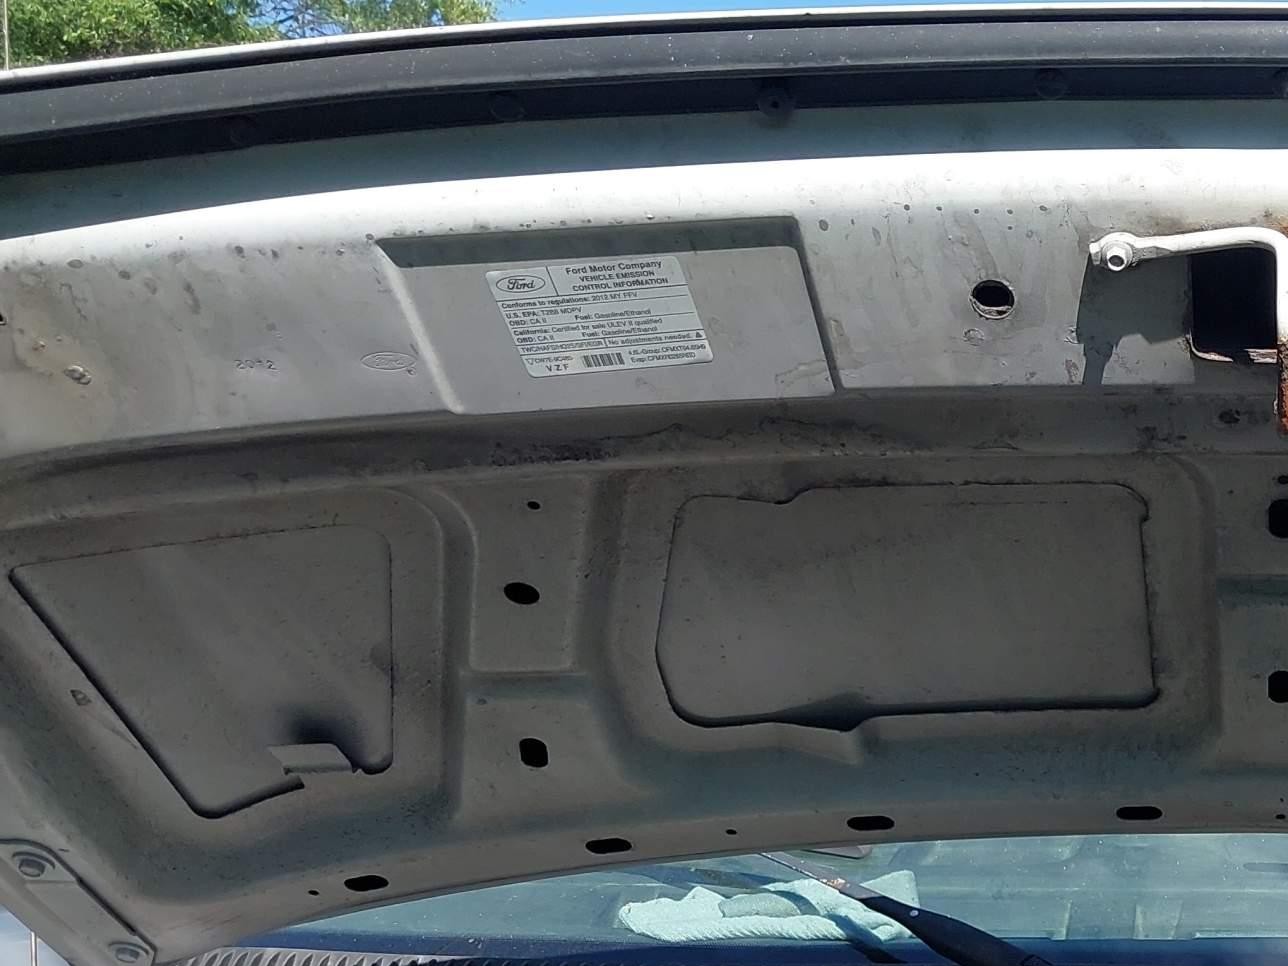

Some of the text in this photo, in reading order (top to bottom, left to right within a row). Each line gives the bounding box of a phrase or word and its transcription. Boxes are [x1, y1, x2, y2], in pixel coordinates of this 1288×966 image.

[565, 261, 662, 275] Ford Motor Company
[579, 269, 655, 283] VEHICLE EMISSION
[506, 278, 536, 290] Ford
[572, 278, 669, 292] CONTROL INFORMATION
[501, 302, 537, 310] Conforms
